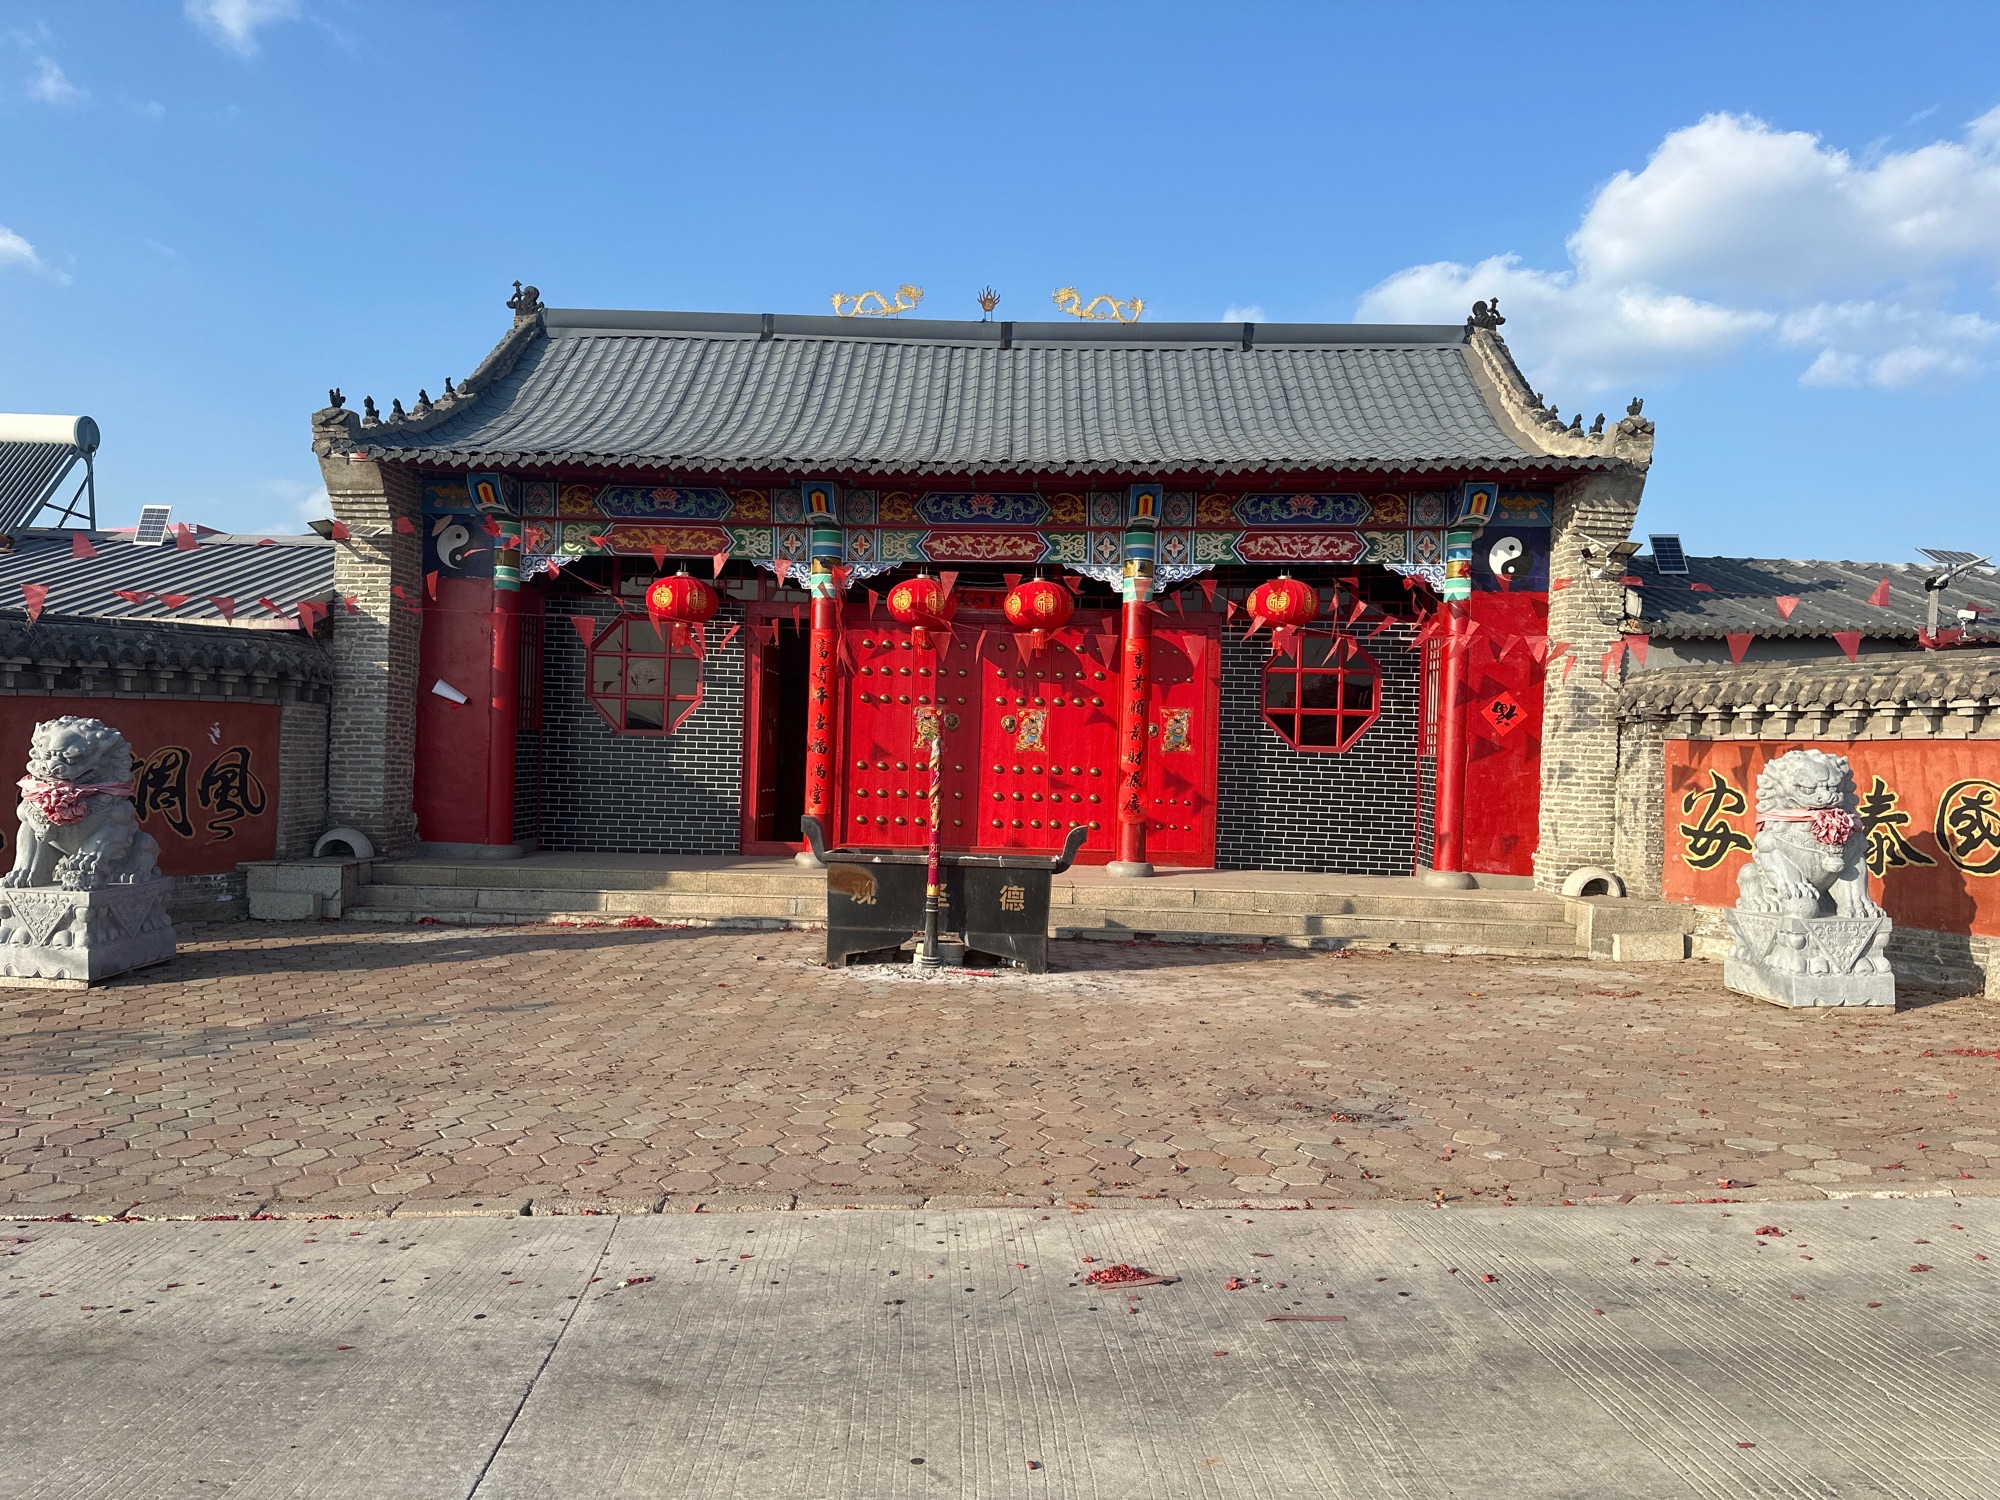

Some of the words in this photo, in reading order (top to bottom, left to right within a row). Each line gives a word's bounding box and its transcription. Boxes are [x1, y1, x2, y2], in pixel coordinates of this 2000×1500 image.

[653, 588, 671, 607] 福
[689, 590, 706, 609] 福
[893, 590, 912, 610] 福
[1036, 594, 1055, 612] 福
